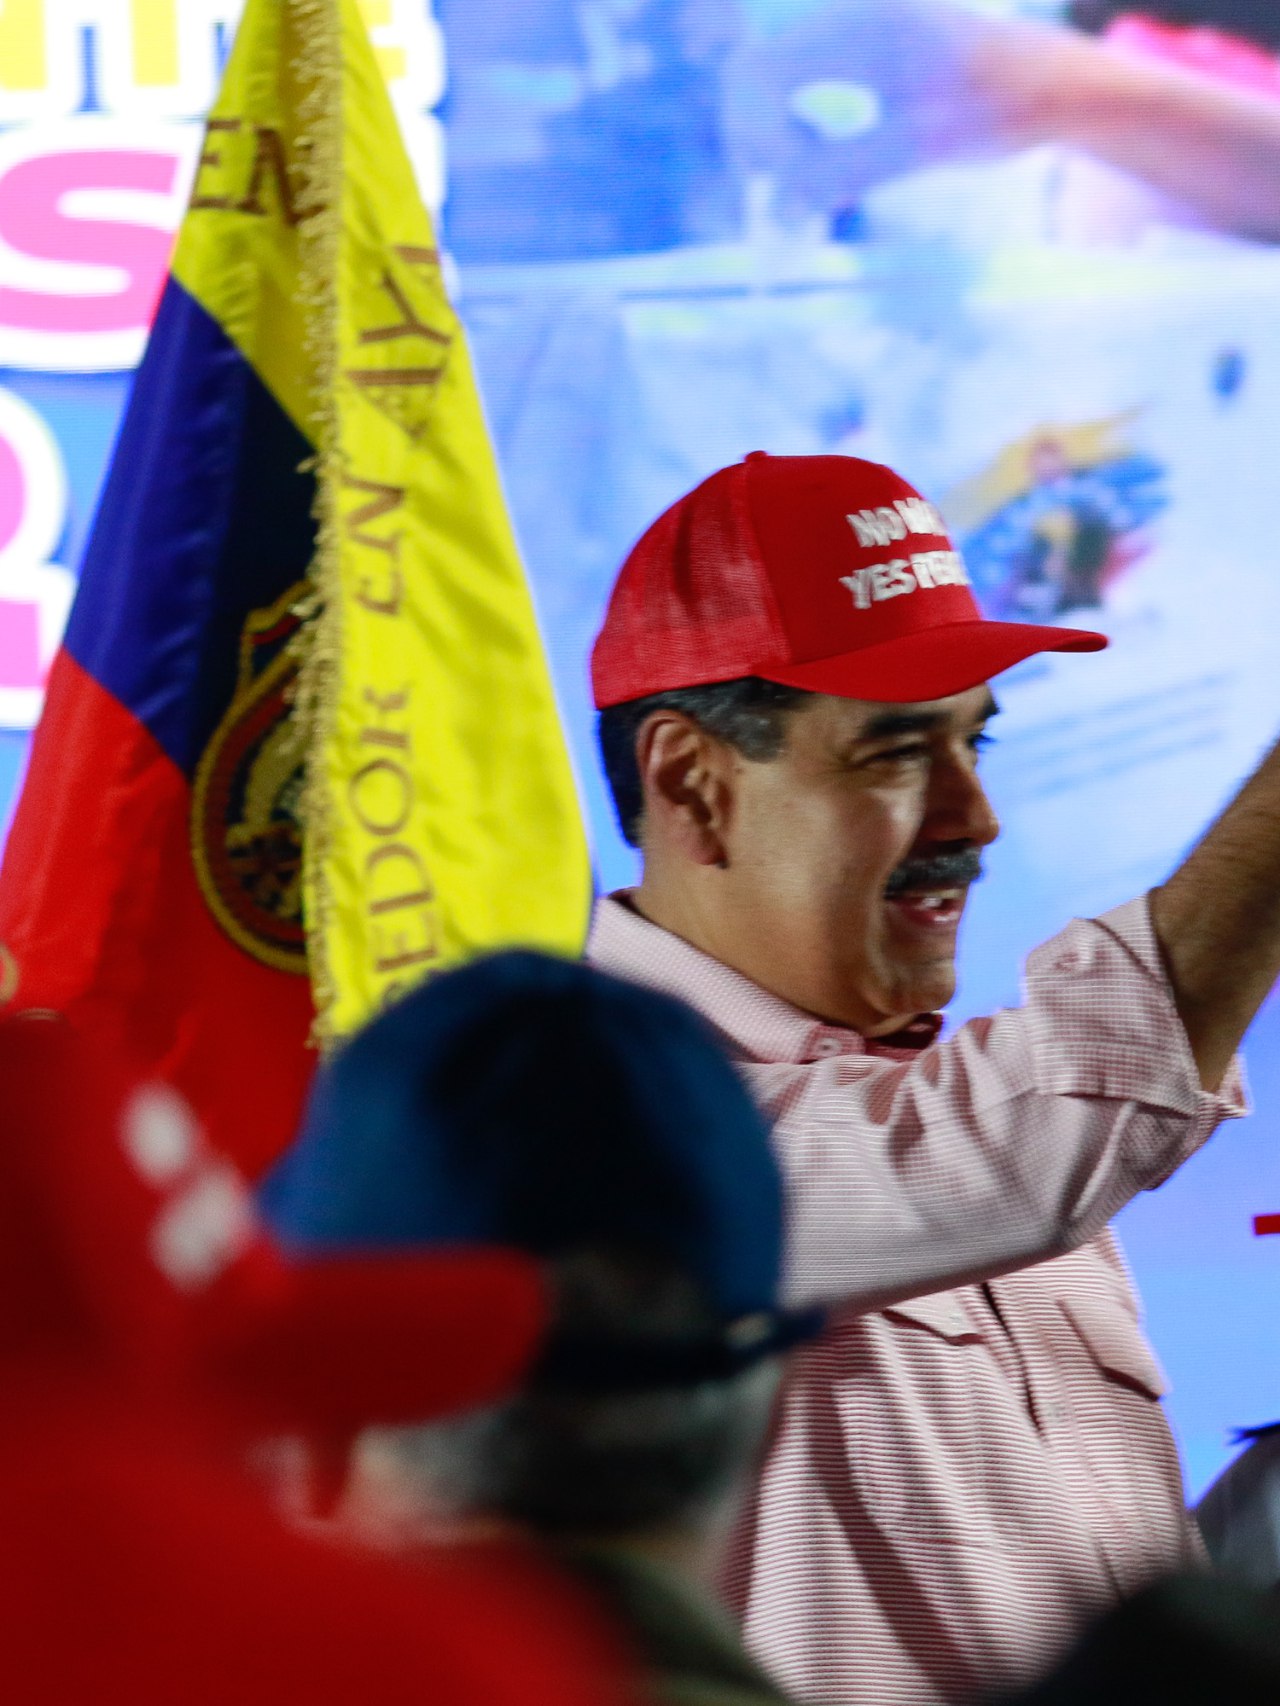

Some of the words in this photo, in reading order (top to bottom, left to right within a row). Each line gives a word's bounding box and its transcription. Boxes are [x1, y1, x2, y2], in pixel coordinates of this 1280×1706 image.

[846, 507, 908, 548] NO
[839, 559, 917, 609] YES
[347, 684, 442, 1002] EDOR
